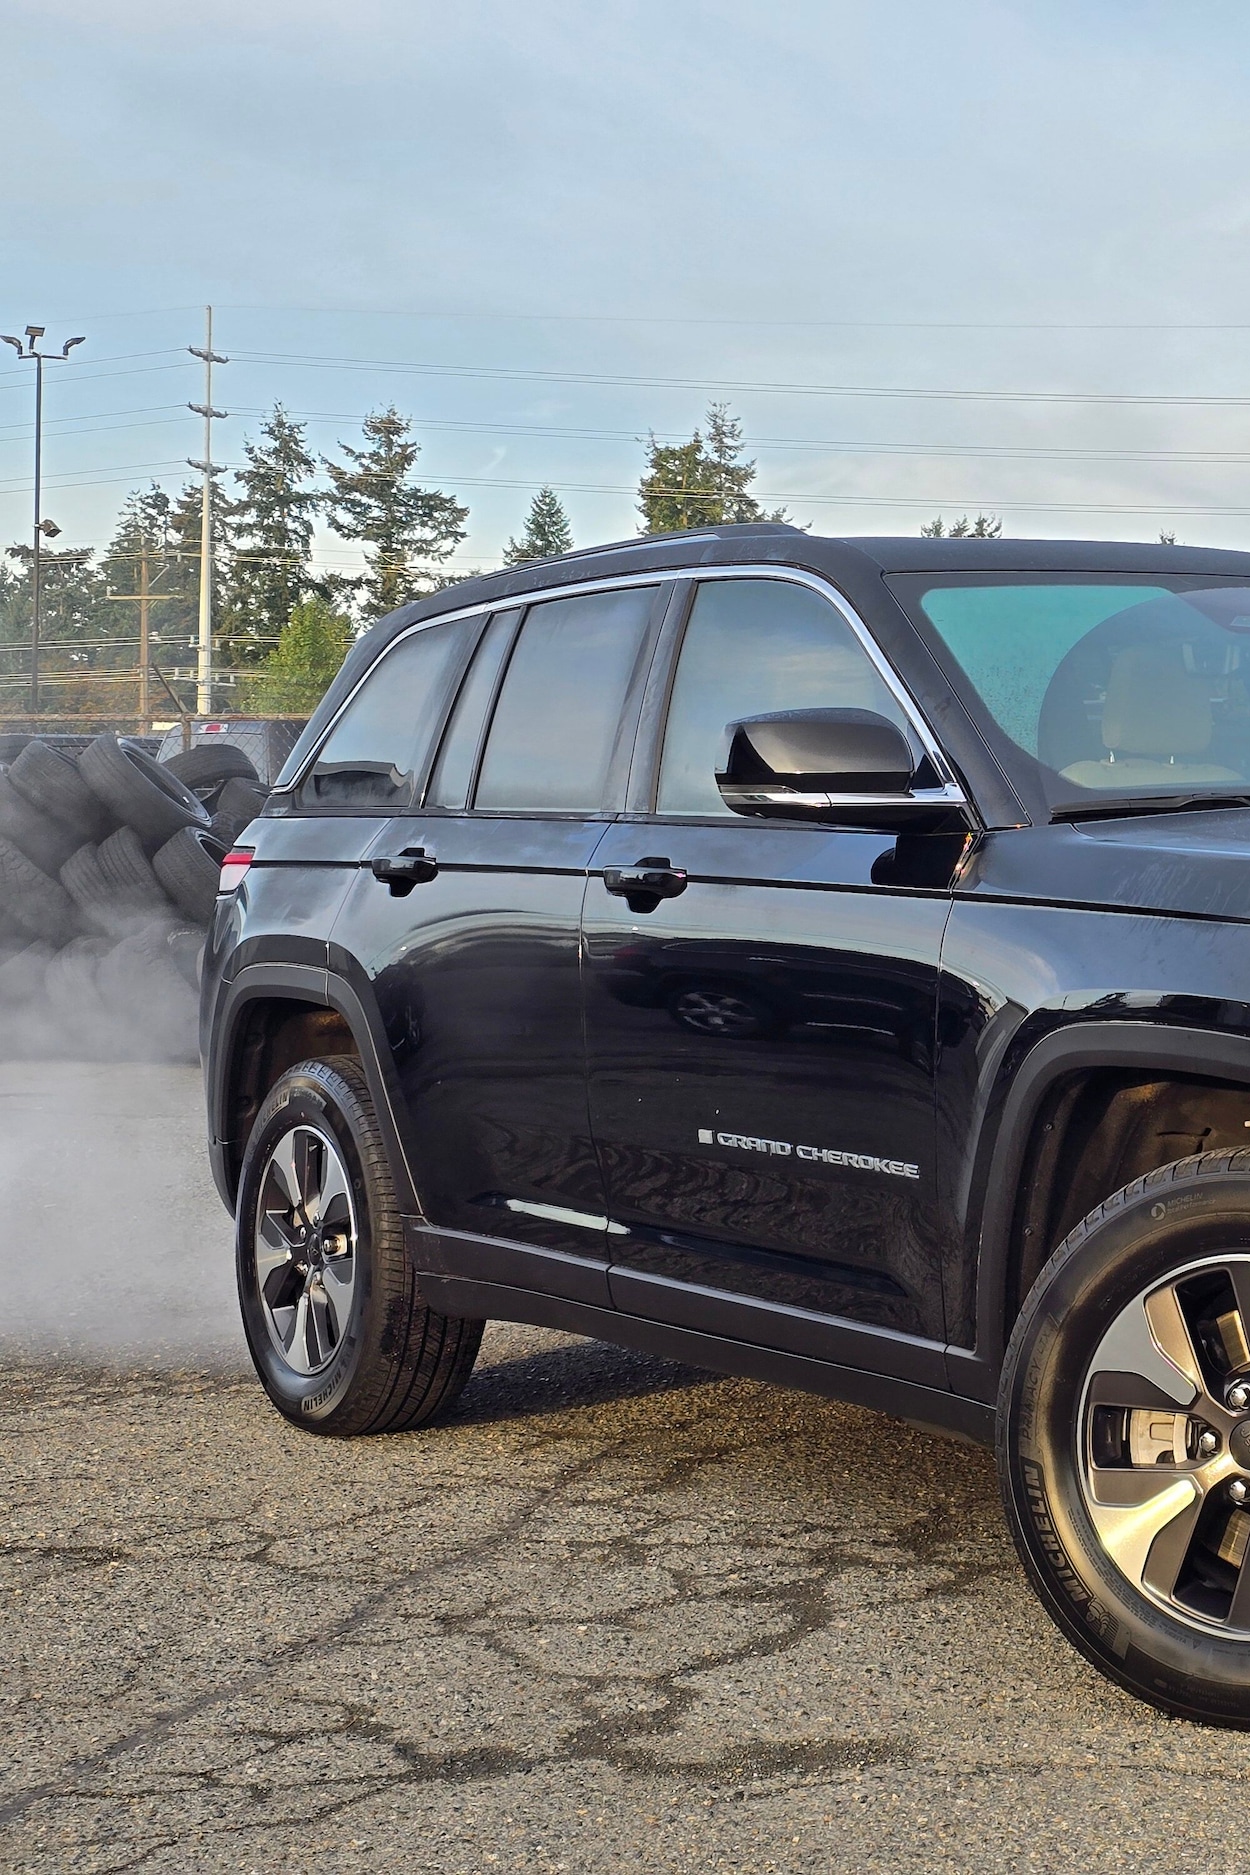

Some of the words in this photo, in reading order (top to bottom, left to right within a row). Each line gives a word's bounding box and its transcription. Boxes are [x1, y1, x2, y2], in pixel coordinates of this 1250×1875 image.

[717, 1132, 791, 1156] GRAND
[796, 1145, 920, 1179] CHEROKEE
[1167, 1192, 1203, 1208] MICHELIN
[304, 1368, 342, 1411] MICHELIN
[1022, 1357, 1042, 1440] PRIMACY
[1038, 1328, 1054, 1354] LTX
[1024, 1465, 1088, 1602] MICHELIN
